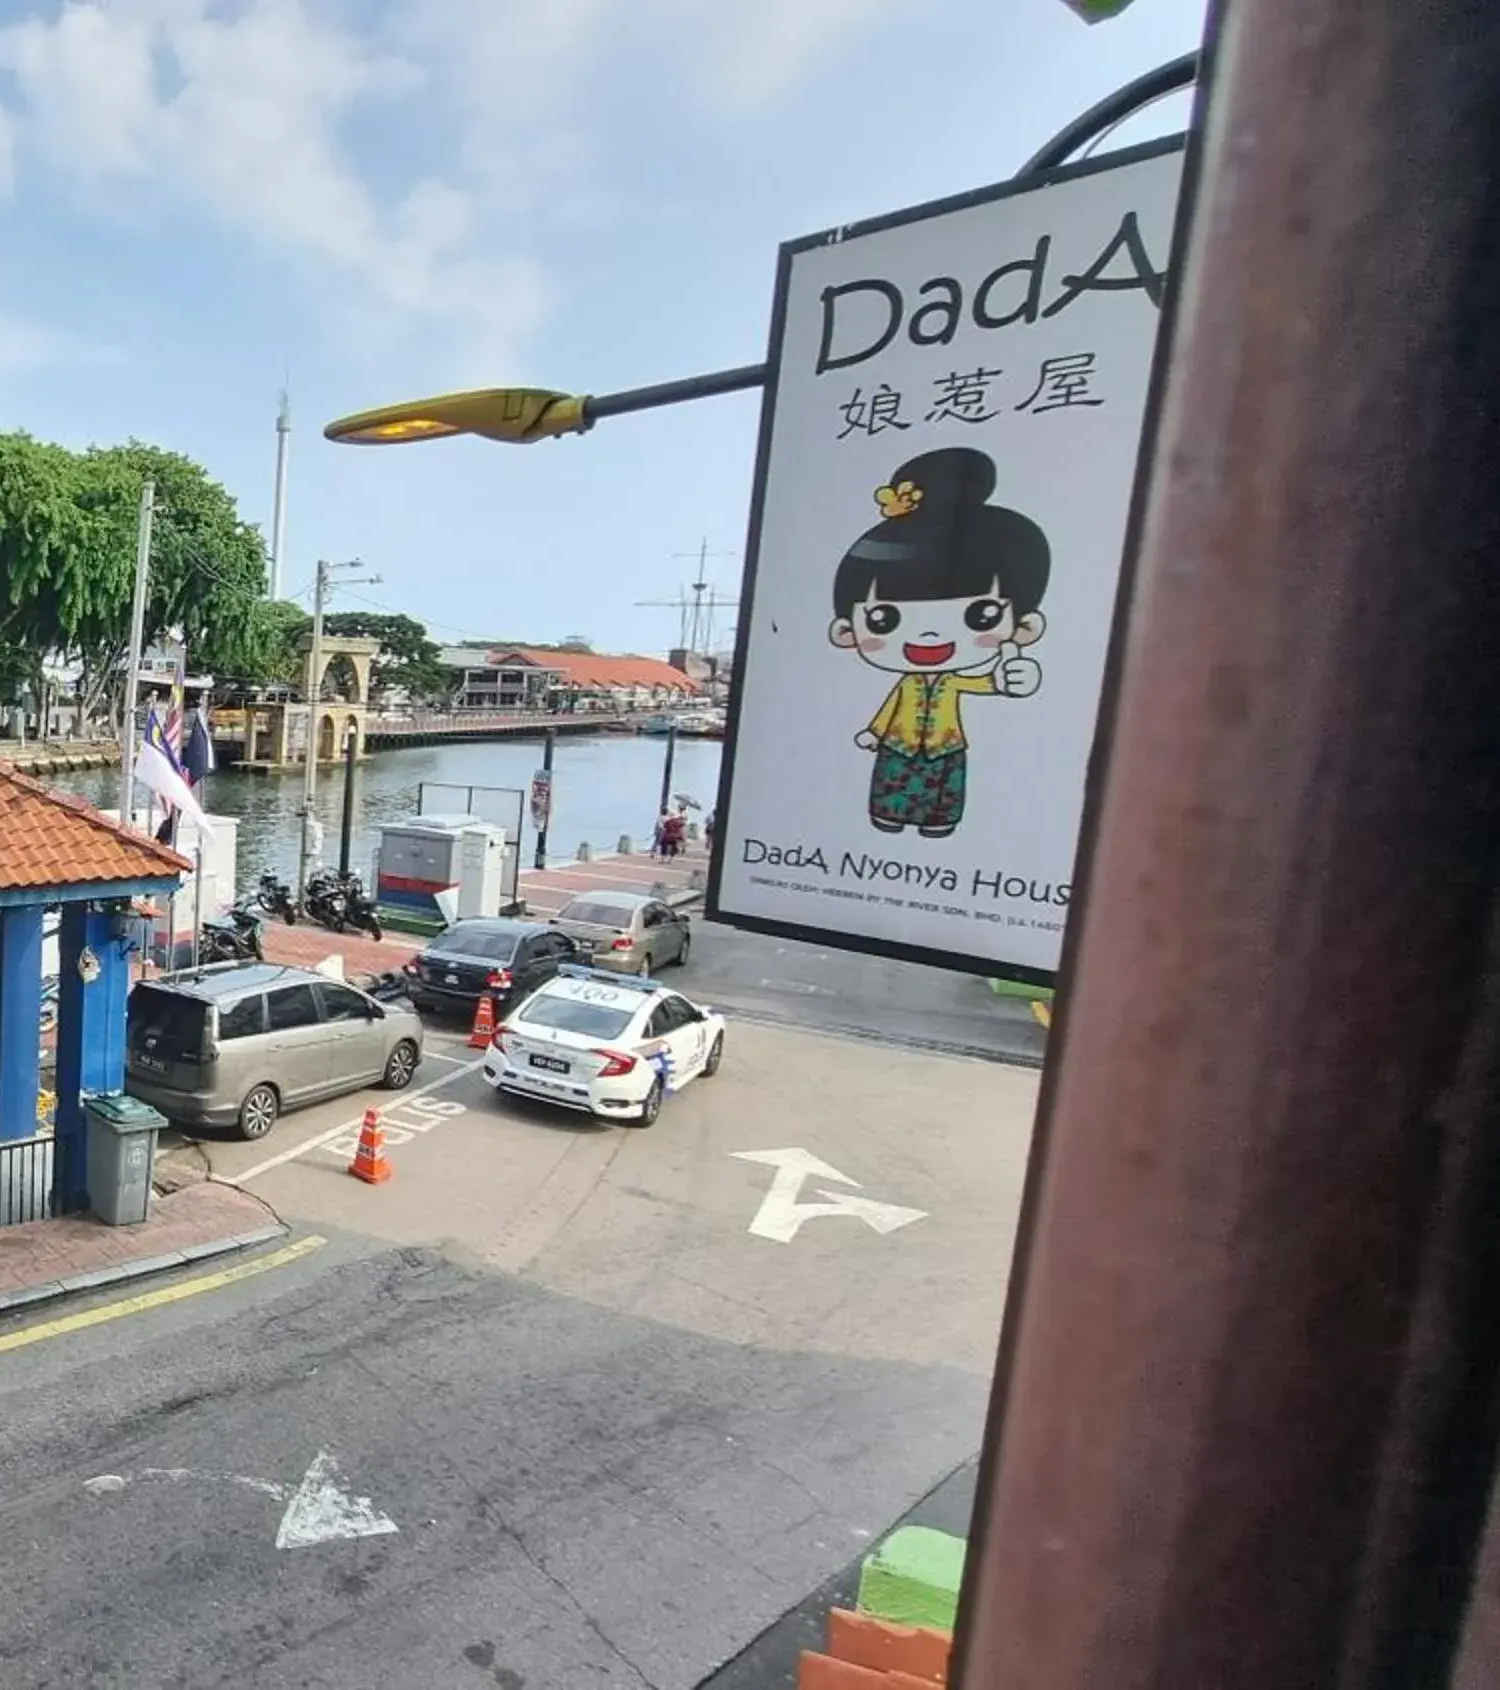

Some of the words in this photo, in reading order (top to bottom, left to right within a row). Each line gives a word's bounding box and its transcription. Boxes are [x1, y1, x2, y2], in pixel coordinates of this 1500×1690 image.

[816, 211, 1166, 375] DadA
[836, 352, 1106, 440] 娘惹屋
[743, 838, 829, 875] DadA
[840, 851, 958, 892] Nyonya
[971, 869, 1073, 906] Hous
[907, 901, 939, 912] RIVER
